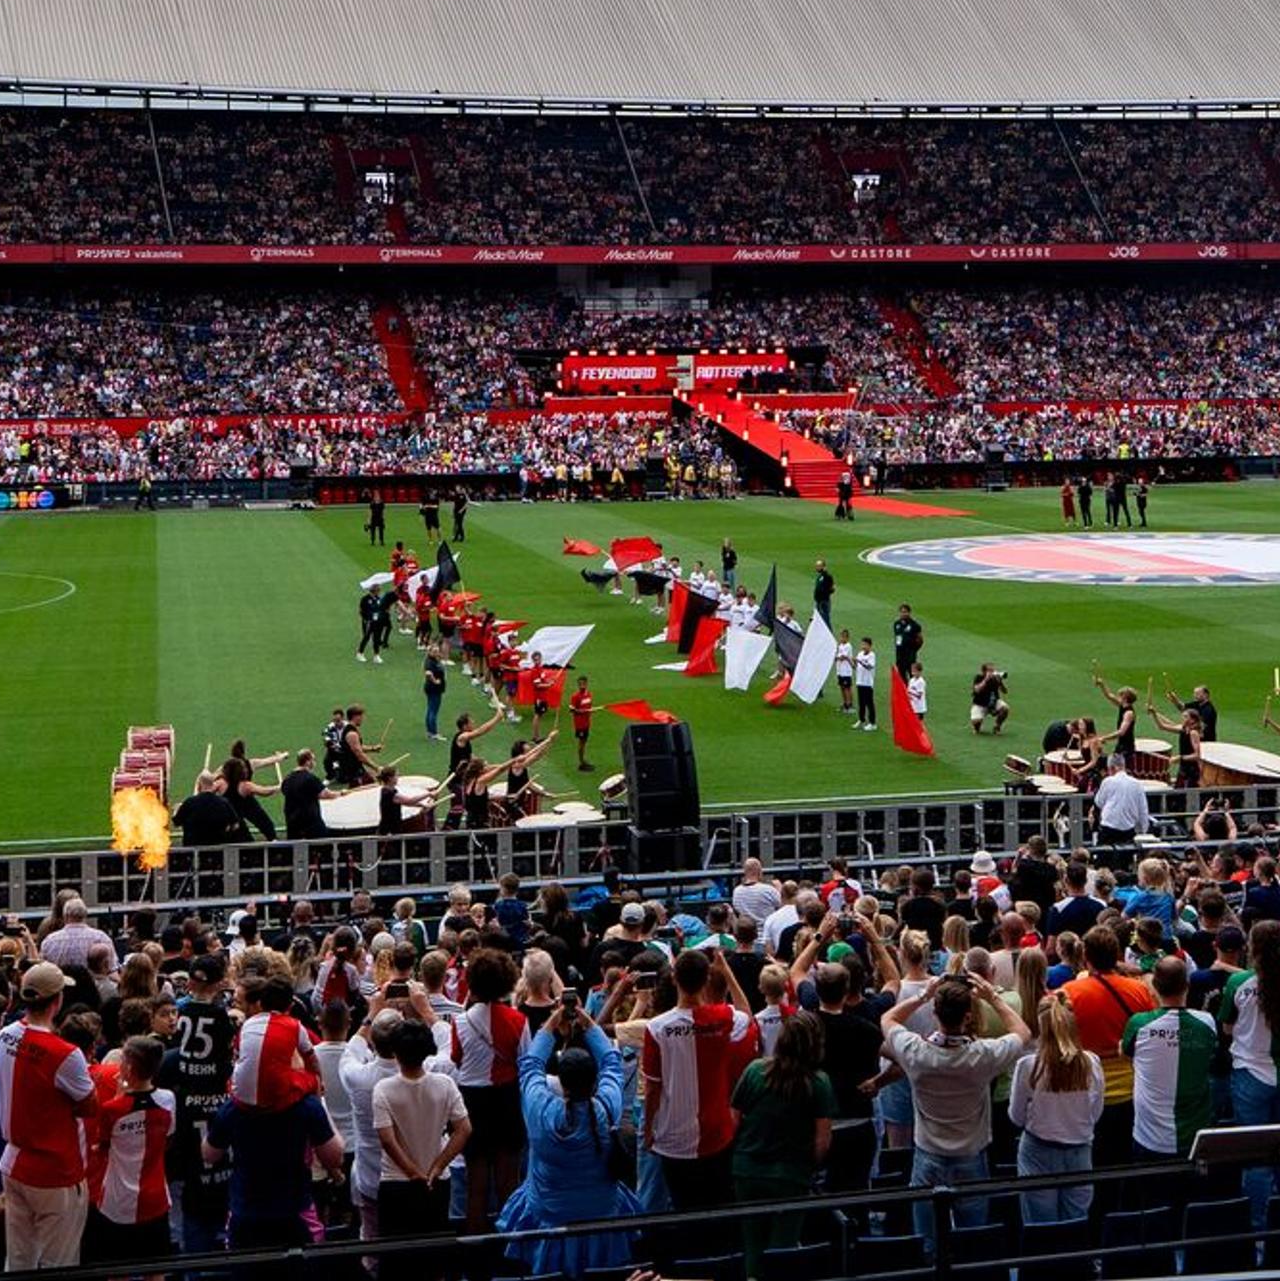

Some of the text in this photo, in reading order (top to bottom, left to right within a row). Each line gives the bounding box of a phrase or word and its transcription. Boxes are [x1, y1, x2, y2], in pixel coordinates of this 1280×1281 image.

[135, 250, 184, 259] vakanties
[851, 249, 911, 258] CASTORE
[991, 248, 1051, 258] CASTORE
[581, 366, 657, 380] FEYENOORD
[177, 1015, 216, 1060] 25
